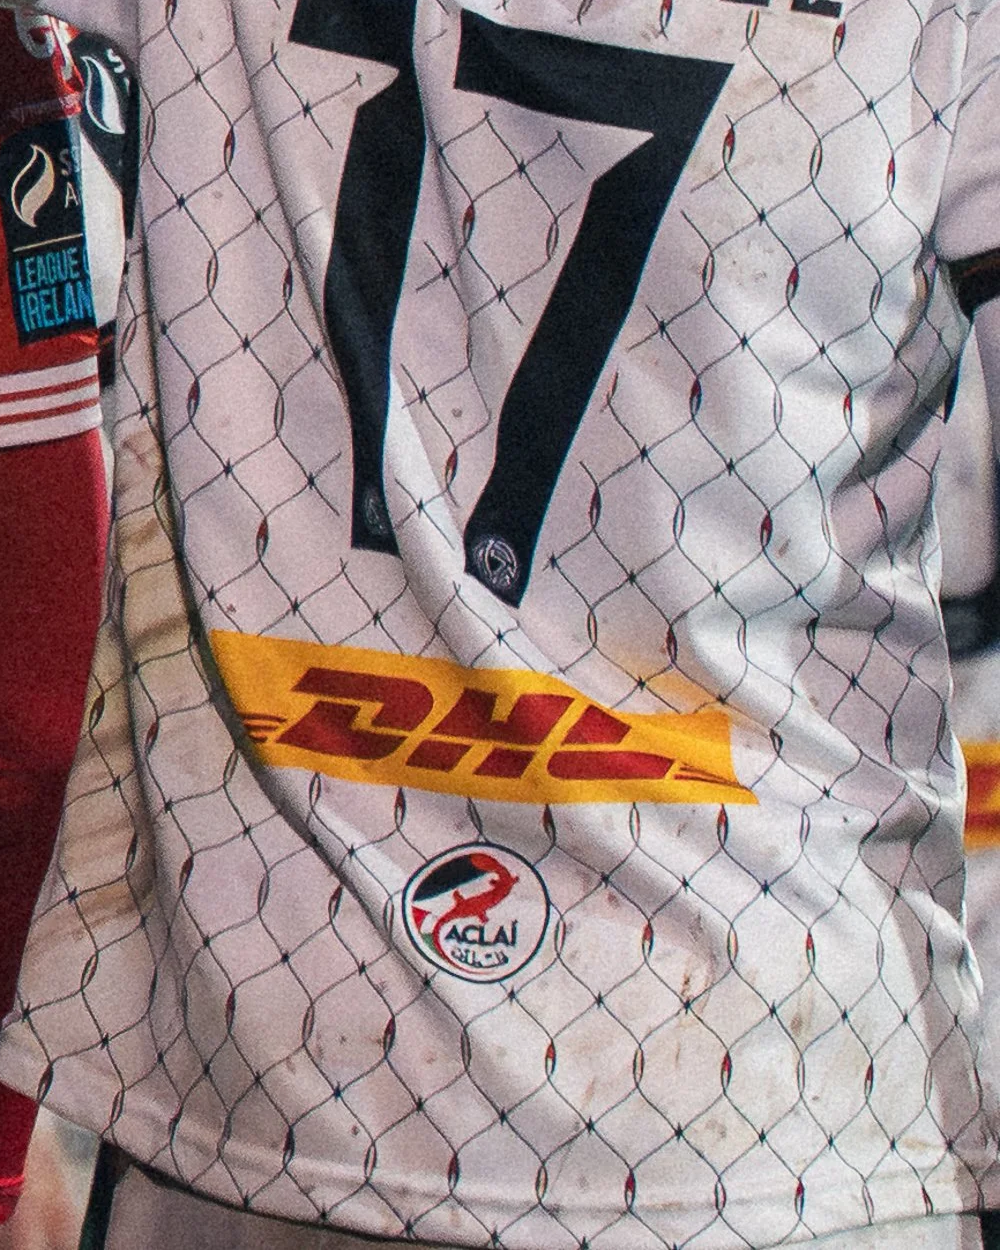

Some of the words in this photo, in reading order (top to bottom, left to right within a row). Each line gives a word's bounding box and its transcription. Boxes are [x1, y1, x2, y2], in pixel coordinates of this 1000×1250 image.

[15, 247, 79, 291] LEAGUE
[20, 280, 95, 332] IRELAN
[274, 666, 675, 780] DHL
